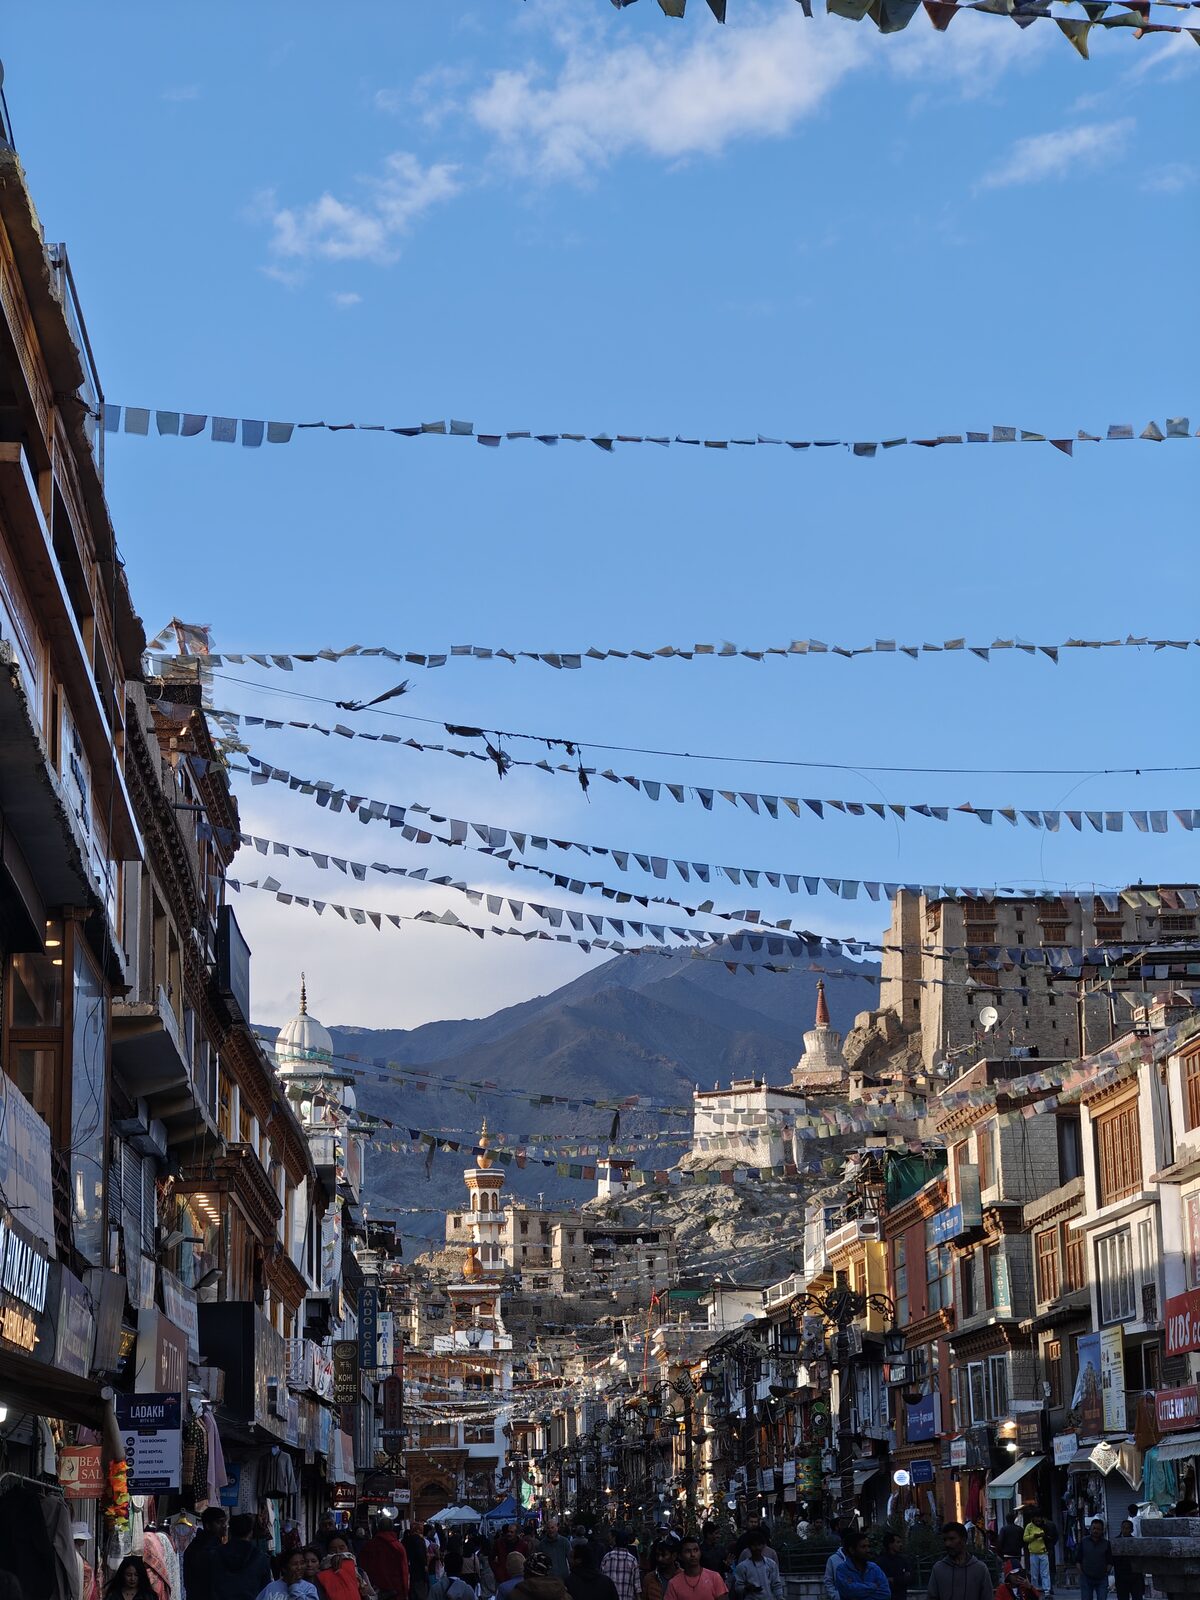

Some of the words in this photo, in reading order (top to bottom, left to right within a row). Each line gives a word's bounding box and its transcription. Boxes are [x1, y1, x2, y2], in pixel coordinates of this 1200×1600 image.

[363, 1290, 372, 1325] AMDO
[1168, 1311, 1191, 1351] KIDS
[363, 1331, 372, 1367] CAFE
[338, 1374, 353, 1382] KOHI
[336, 1394, 354, 1403] SHOP
[131, 1405, 164, 1418] LADAKH
[1158, 1398, 1174, 1421] LITTLE
[336, 1488, 354, 1496] ATM
